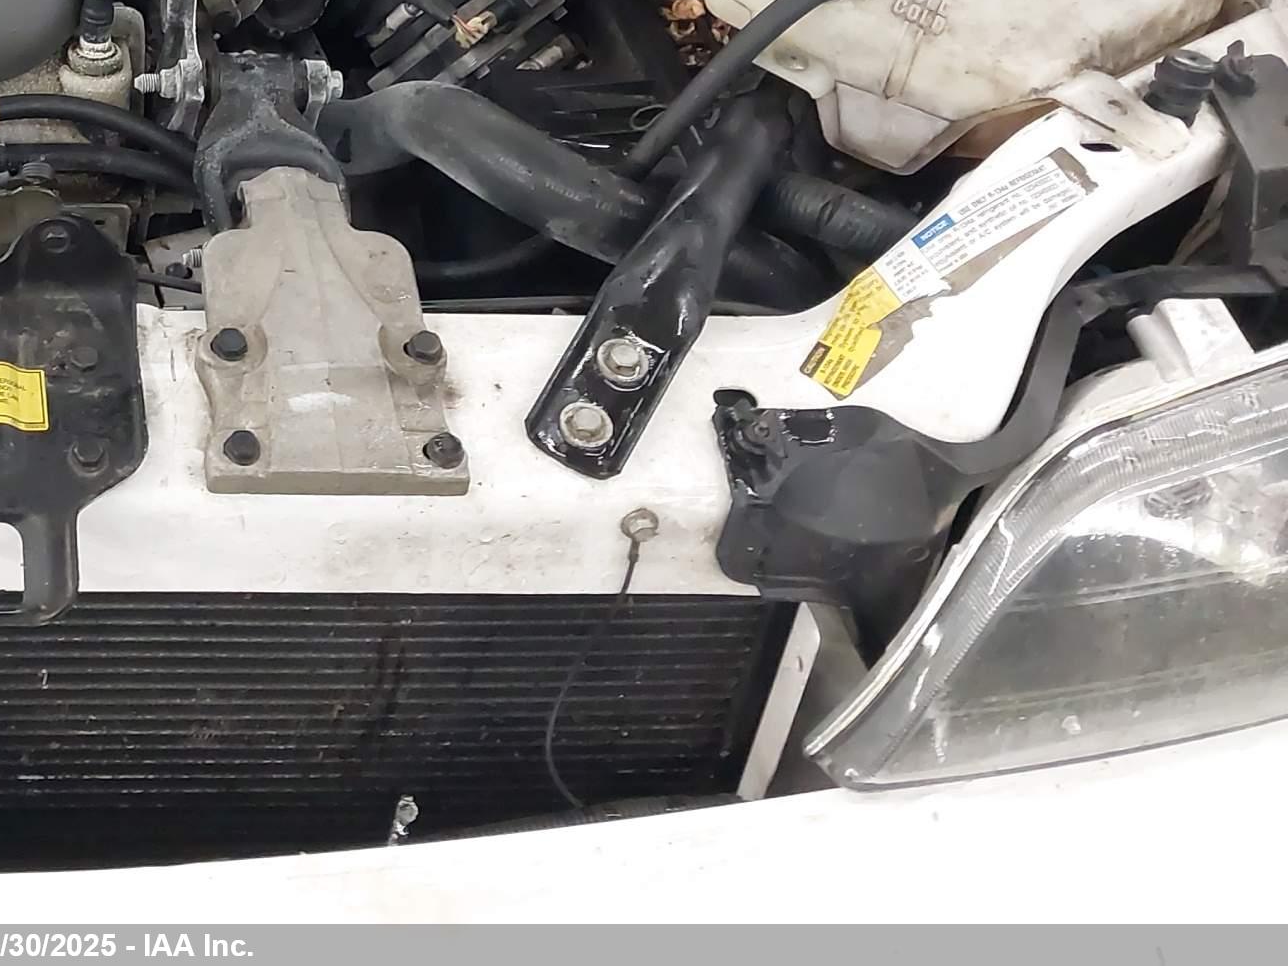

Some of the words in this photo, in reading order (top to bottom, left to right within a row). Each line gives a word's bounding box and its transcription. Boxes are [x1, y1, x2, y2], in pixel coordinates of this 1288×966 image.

[958, 205, 972, 216] USE
[971, 196, 987, 209] ONLY
[920, 220, 951, 242] NOTICE
